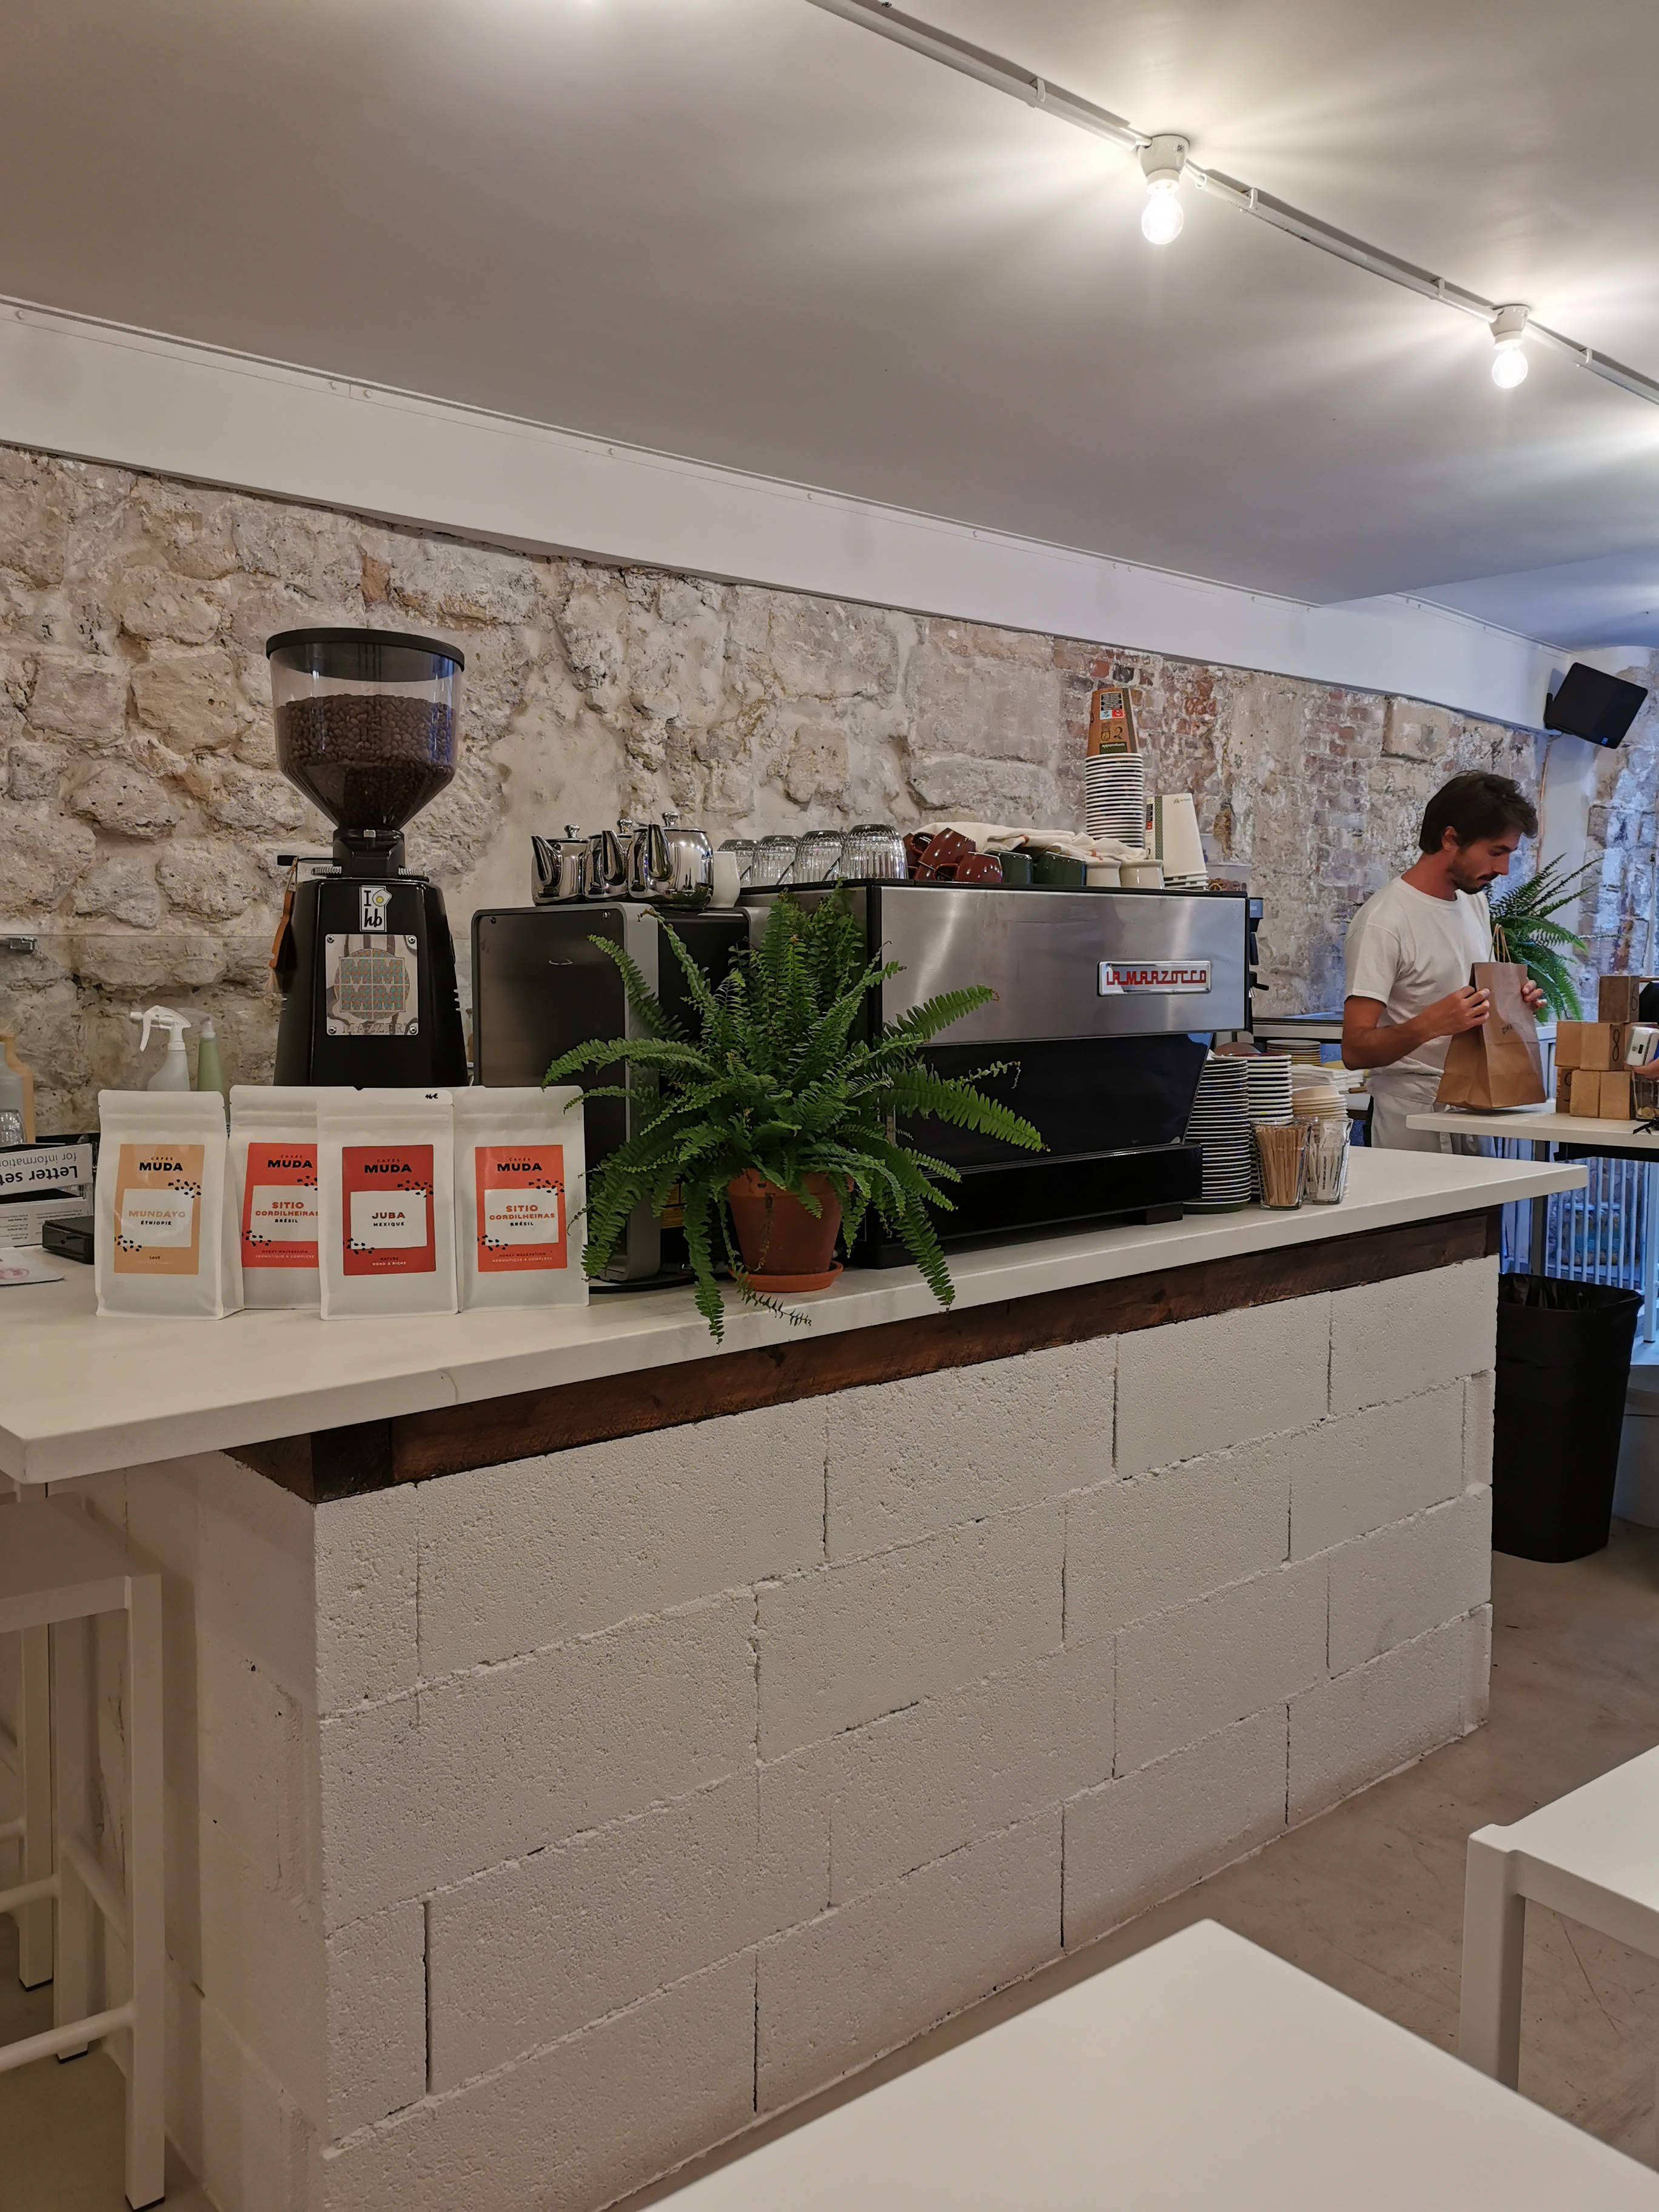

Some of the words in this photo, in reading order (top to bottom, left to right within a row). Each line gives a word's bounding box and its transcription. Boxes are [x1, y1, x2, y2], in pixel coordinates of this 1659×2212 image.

[364, 890, 372, 907] I
[364, 908, 383, 928] hb
[1612, 1028, 1621, 1062] 8
[0, 1154, 58, 1168] informatio
[62, 1152, 77, 1162] for
[139, 1162, 184, 1171] MUDA
[267, 1160, 313, 1168] MUDA
[364, 1164, 412, 1173] MUDA
[497, 1163, 543, 1171] MUDA
[29, 1165, 78, 1181] Letter
